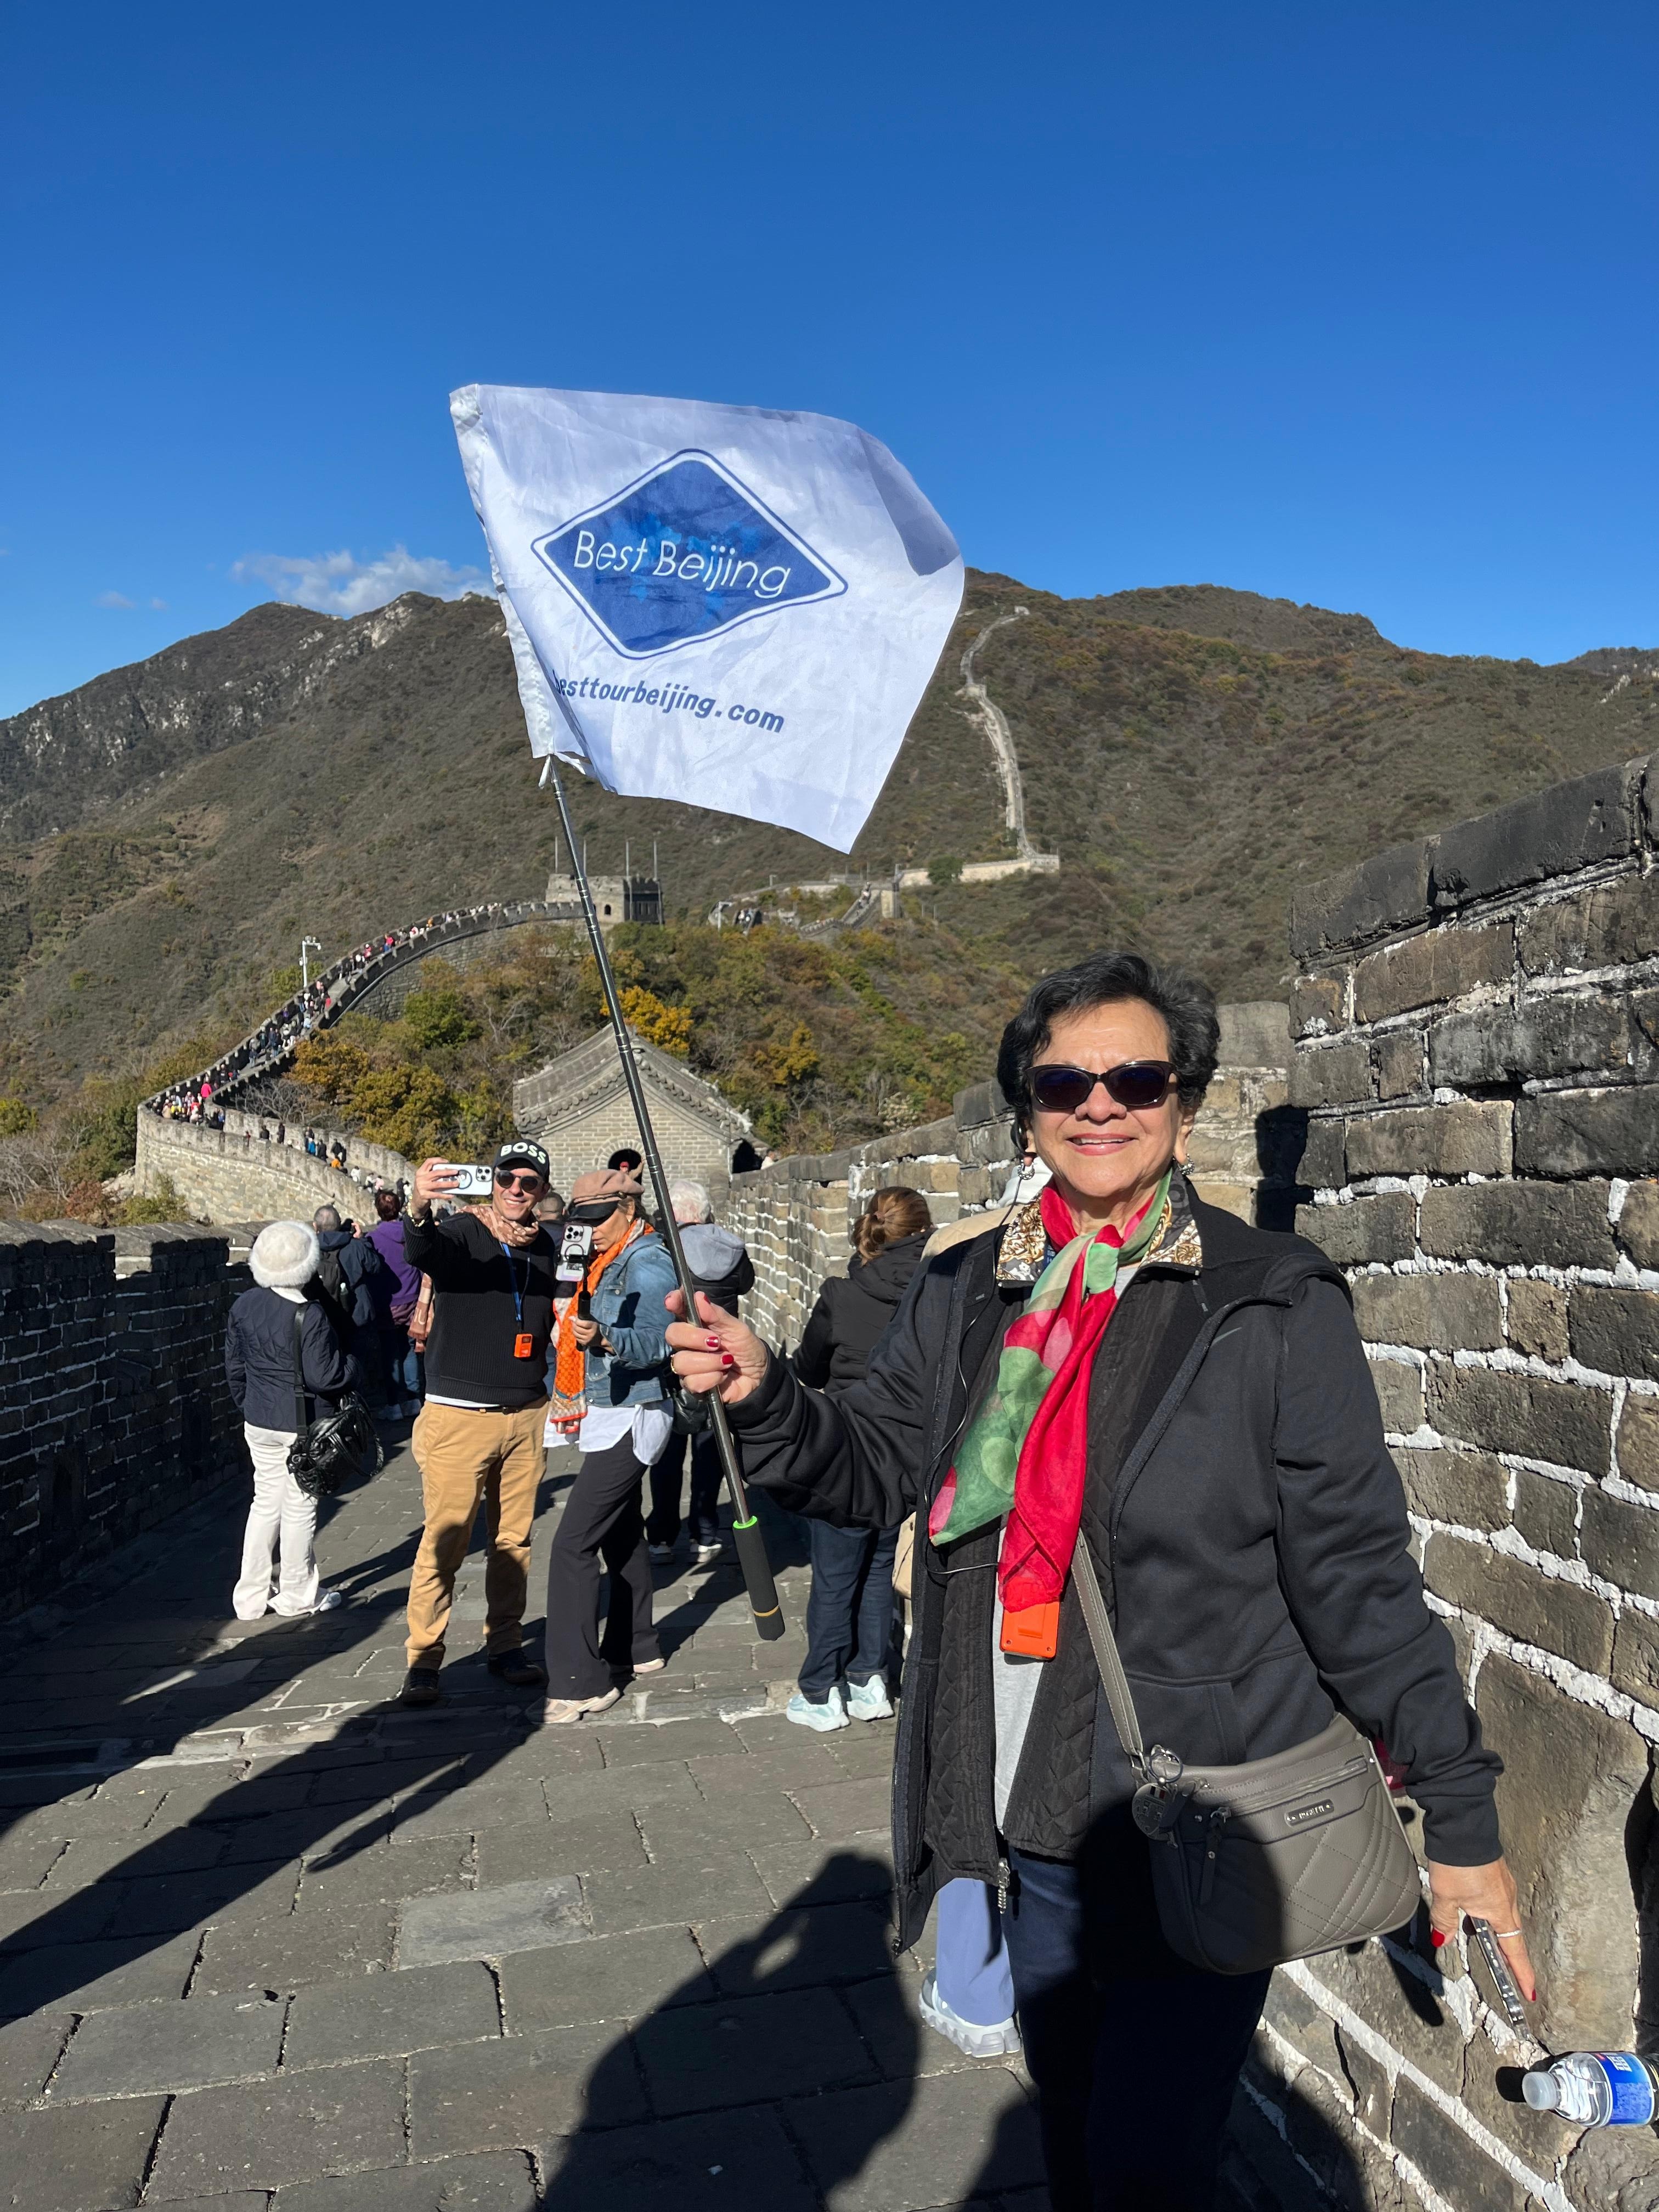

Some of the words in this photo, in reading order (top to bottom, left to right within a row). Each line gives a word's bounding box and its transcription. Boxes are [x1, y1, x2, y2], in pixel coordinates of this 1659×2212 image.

[574, 530, 648, 573] Best
[653, 540, 791, 599] Beijing
[500, 1142, 546, 1164] BOSS
